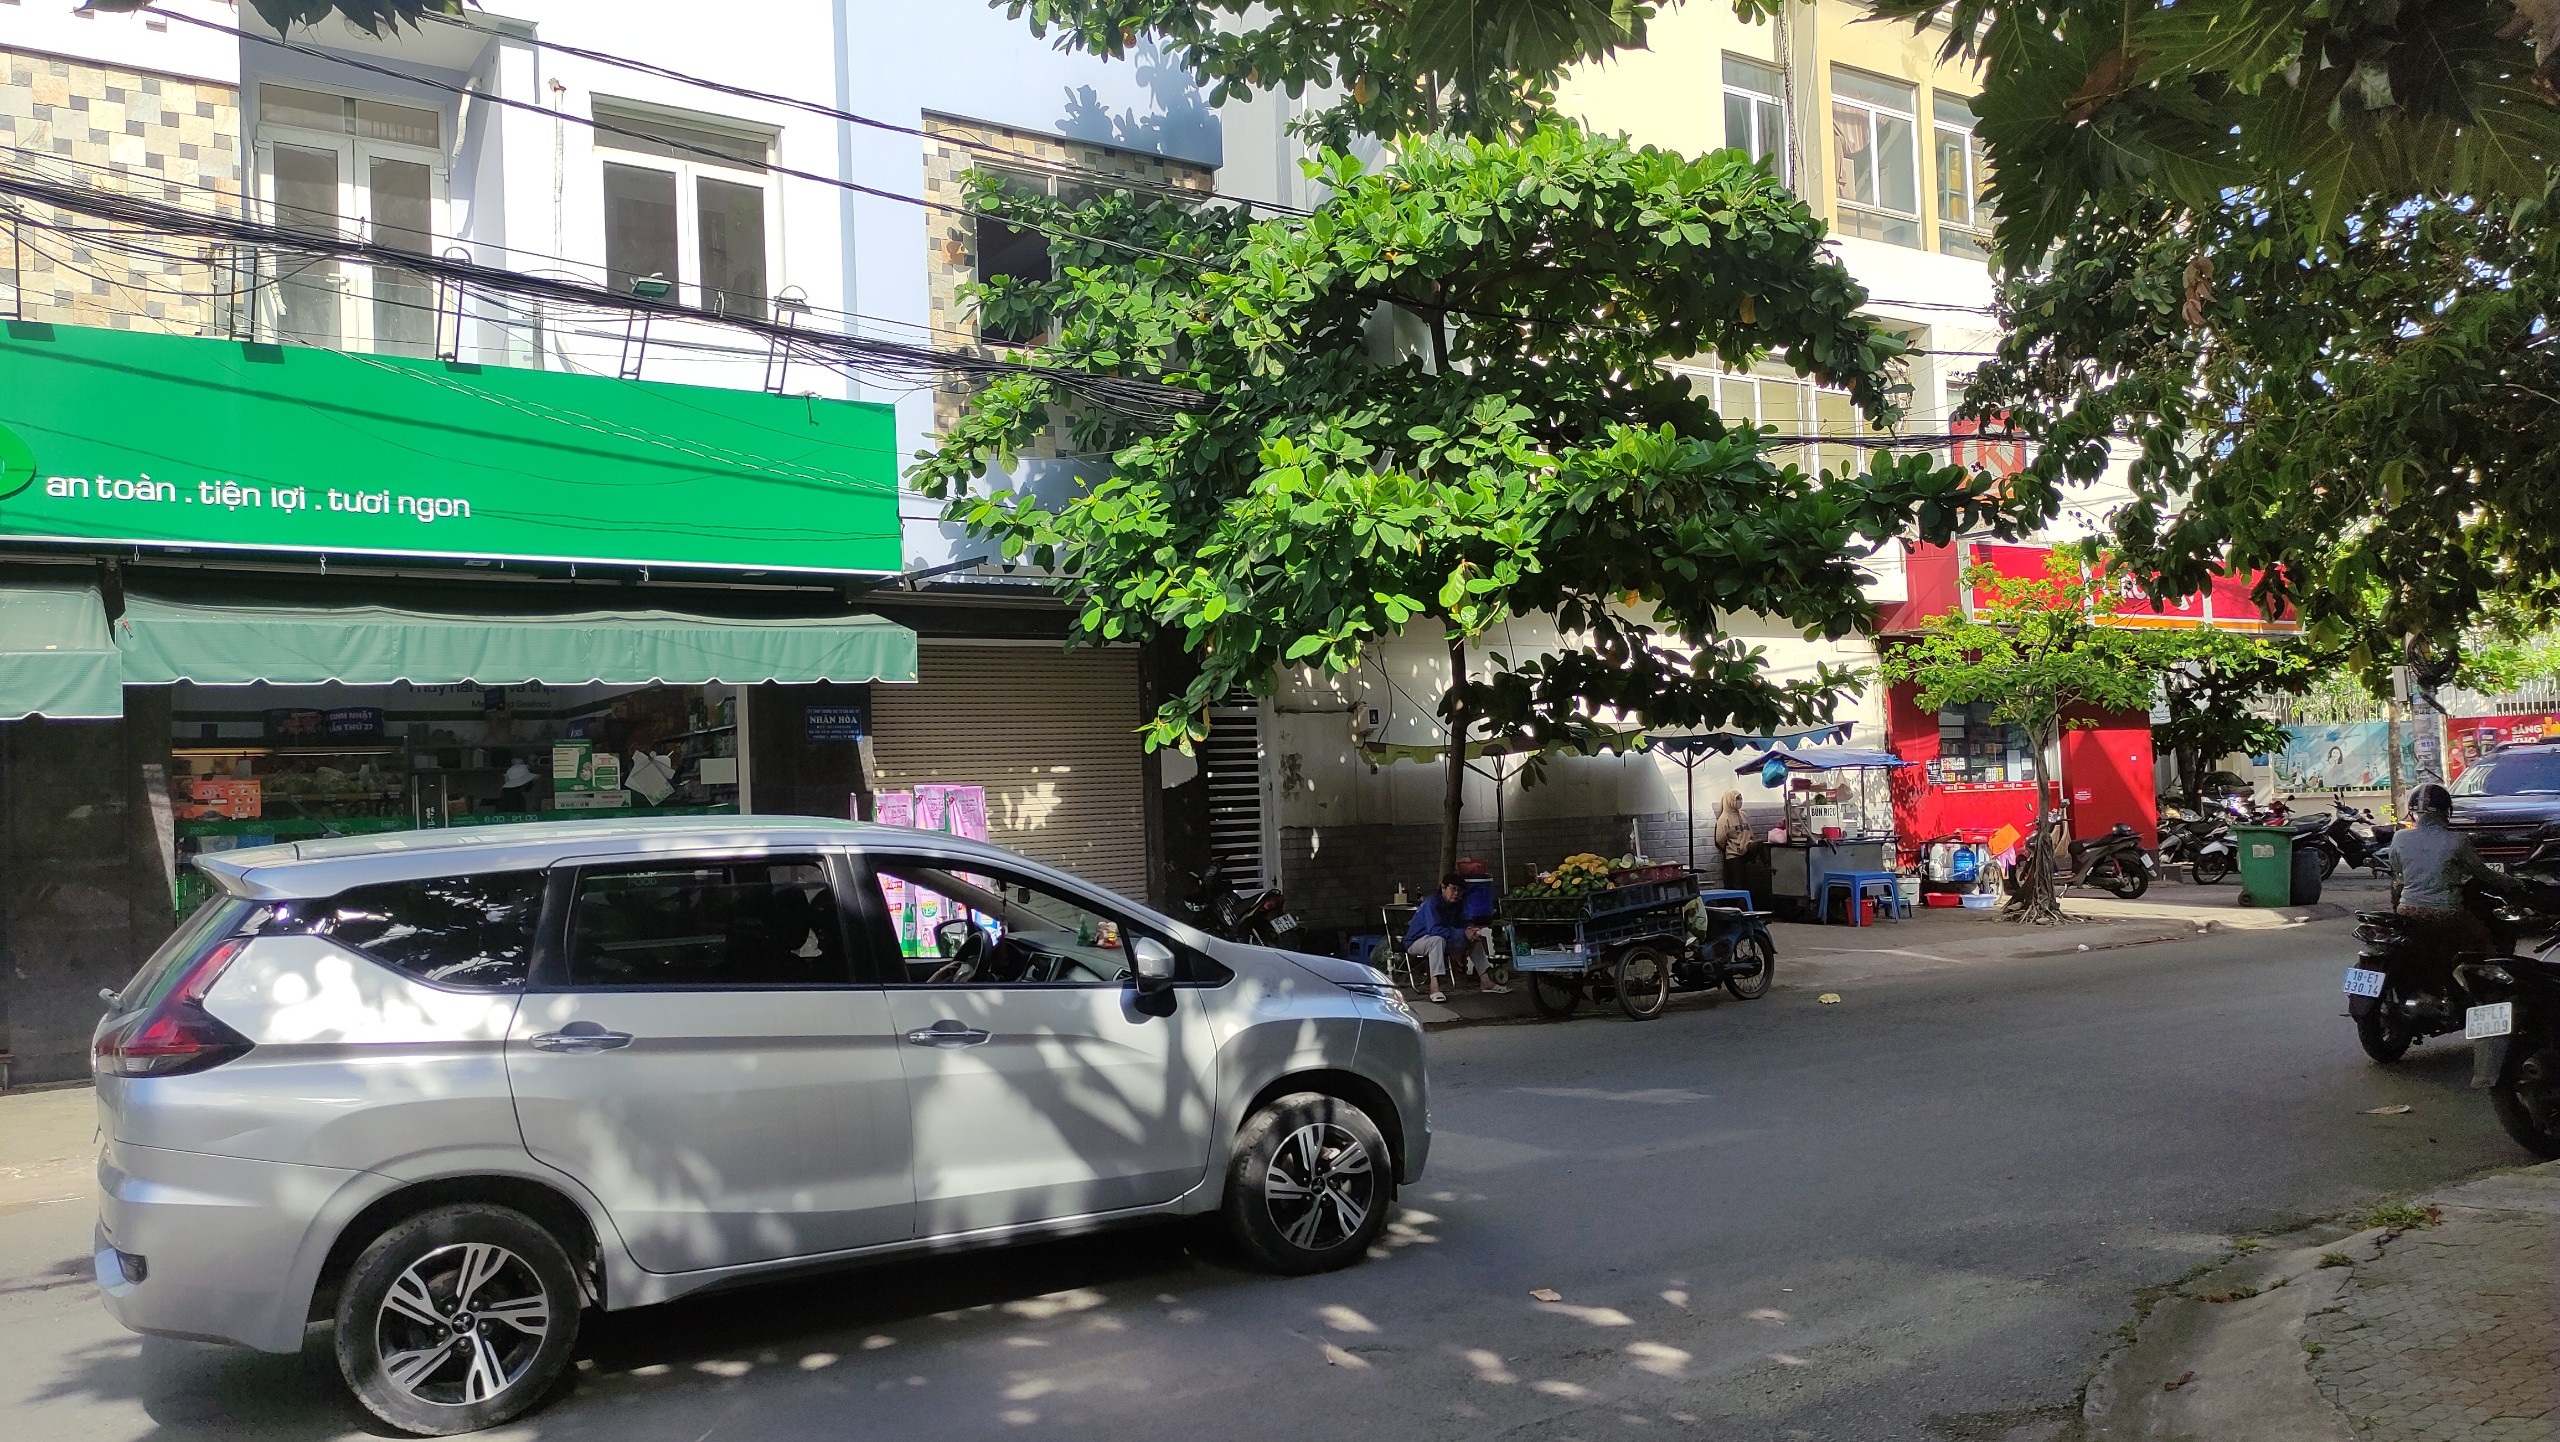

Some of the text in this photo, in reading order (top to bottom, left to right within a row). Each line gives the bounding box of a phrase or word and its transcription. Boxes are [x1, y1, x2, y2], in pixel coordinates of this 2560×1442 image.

[46, 472, 471, 524] an toàn tiện lợi tươi ngon
[838, 713, 858, 724] HÒA
[1811, 805, 1823, 817] BÚN
[627, 877, 657, 888] FOOD
[2352, 970, 2379, 984] 18-E1
